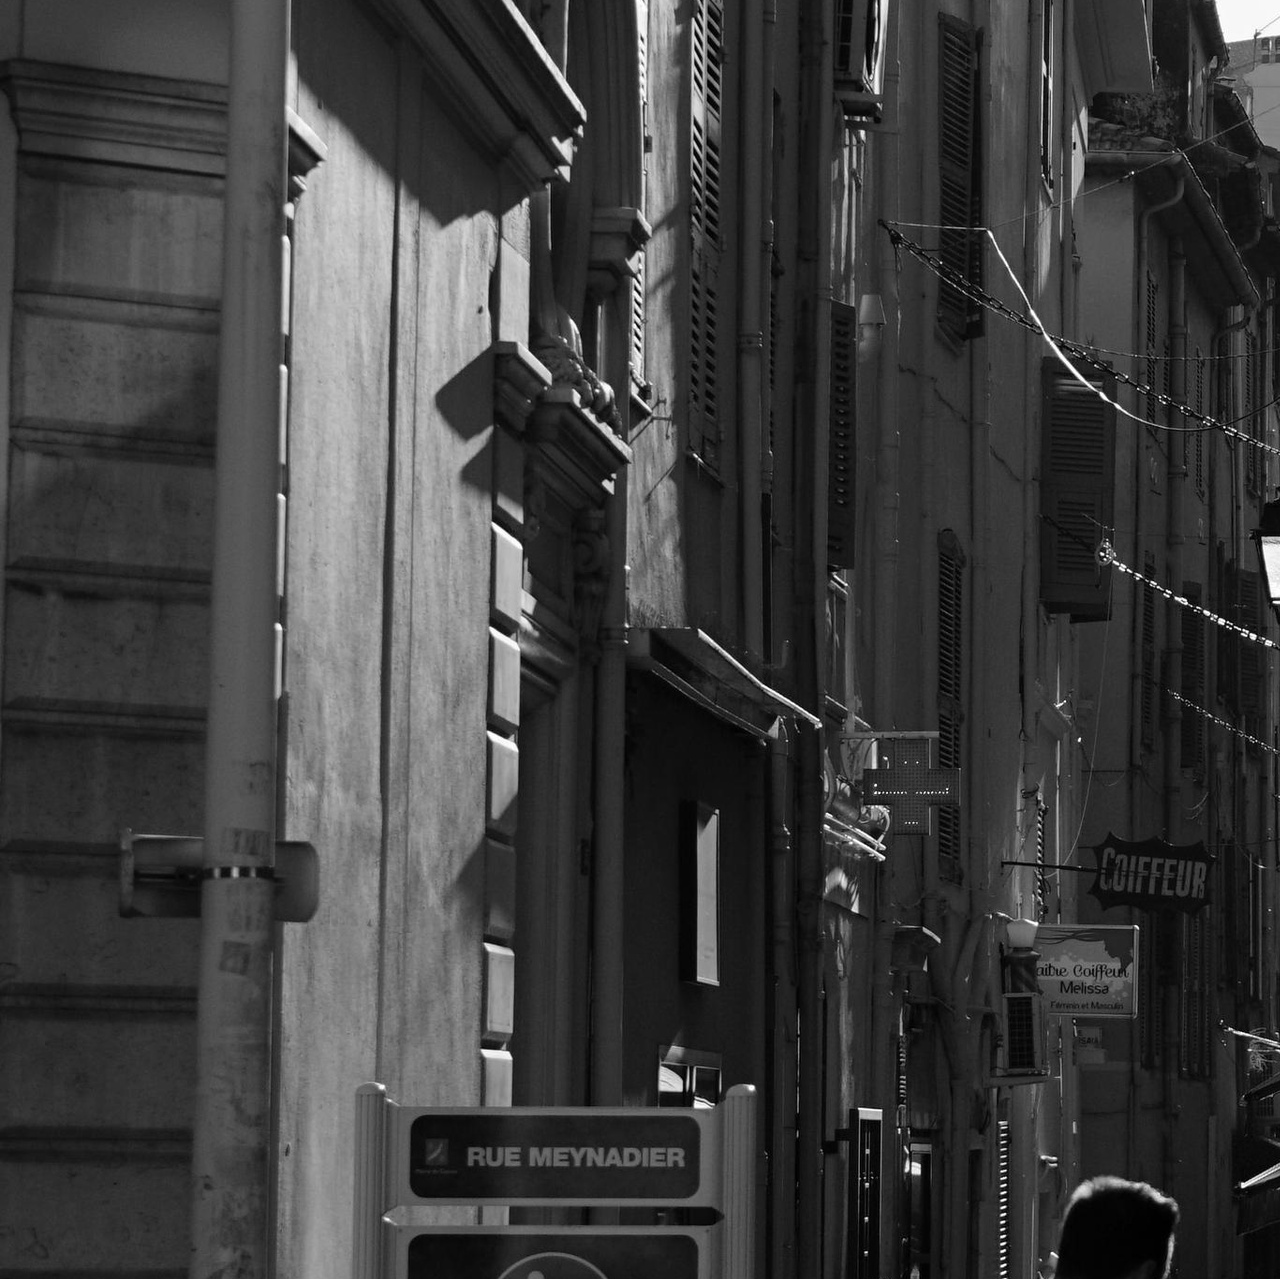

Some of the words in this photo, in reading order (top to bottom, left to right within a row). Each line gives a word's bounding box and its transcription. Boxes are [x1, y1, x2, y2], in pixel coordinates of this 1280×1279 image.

[1100, 847, 1207, 899] COIFFEUR
[1060, 981, 1109, 995] Melissa
[467, 1146, 522, 1168] RUE
[529, 1146, 686, 1168] MEYNADIER
